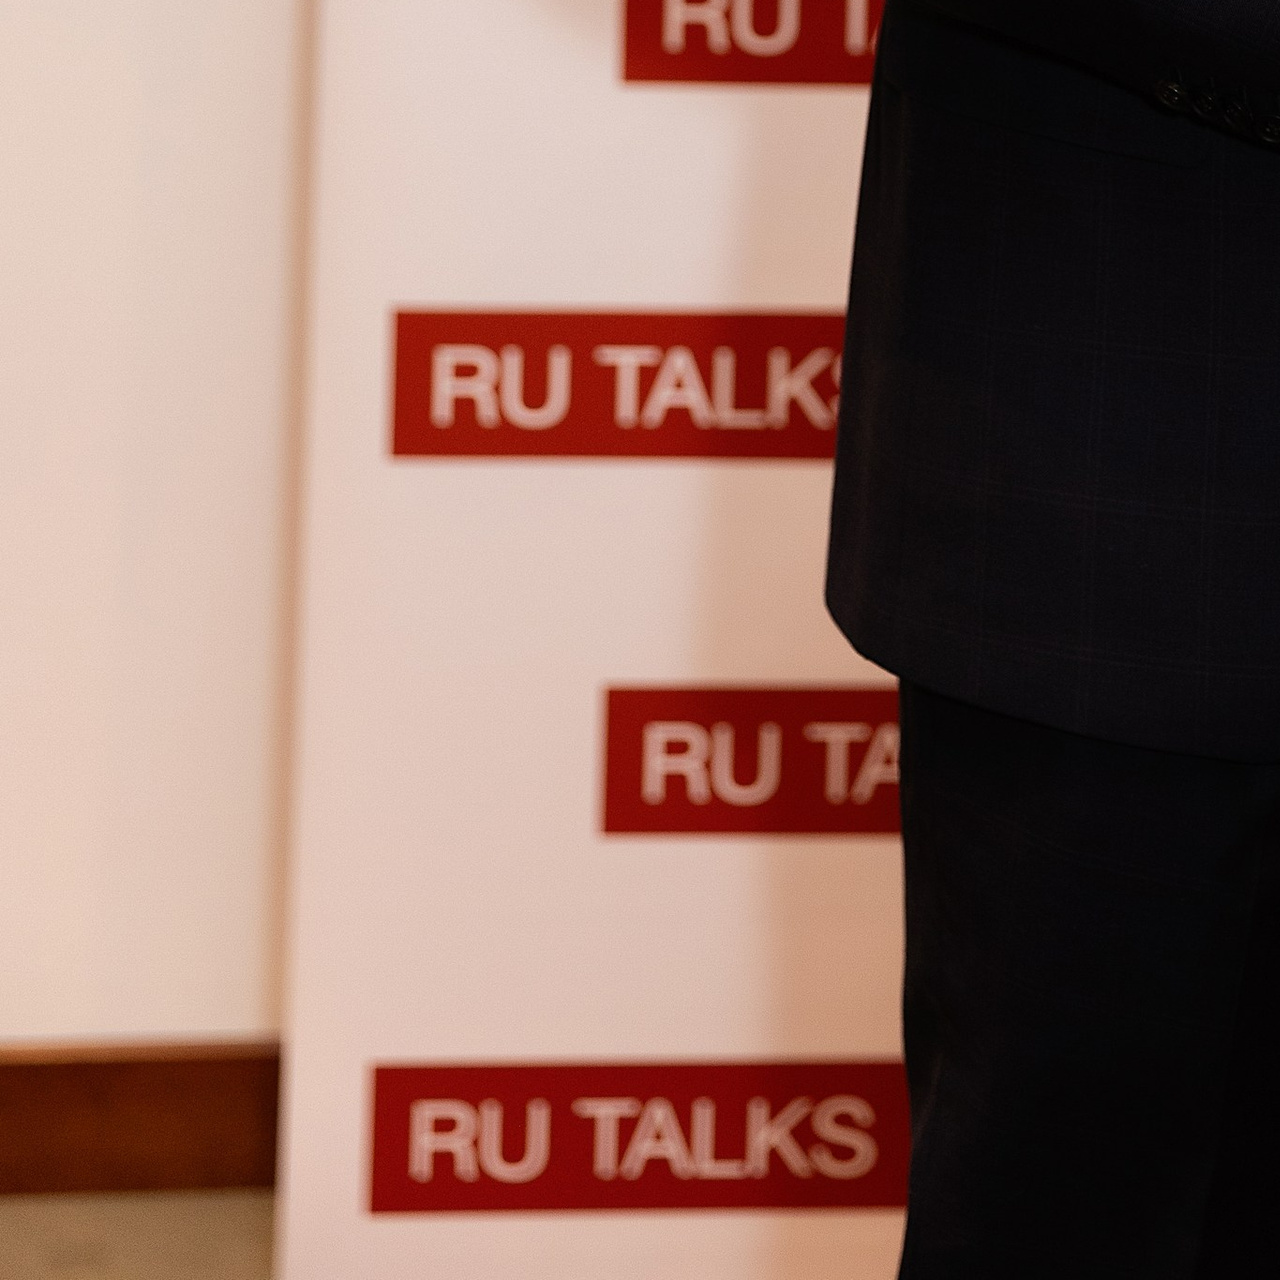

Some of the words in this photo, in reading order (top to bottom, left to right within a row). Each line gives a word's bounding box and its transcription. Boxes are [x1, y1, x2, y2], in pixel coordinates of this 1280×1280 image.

[429, 342, 573, 432] RU
[591, 343, 842, 432] TALK
[640, 720, 783, 808] RU
[408, 1097, 552, 1184] RU
[570, 1094, 880, 1181] TALKS
